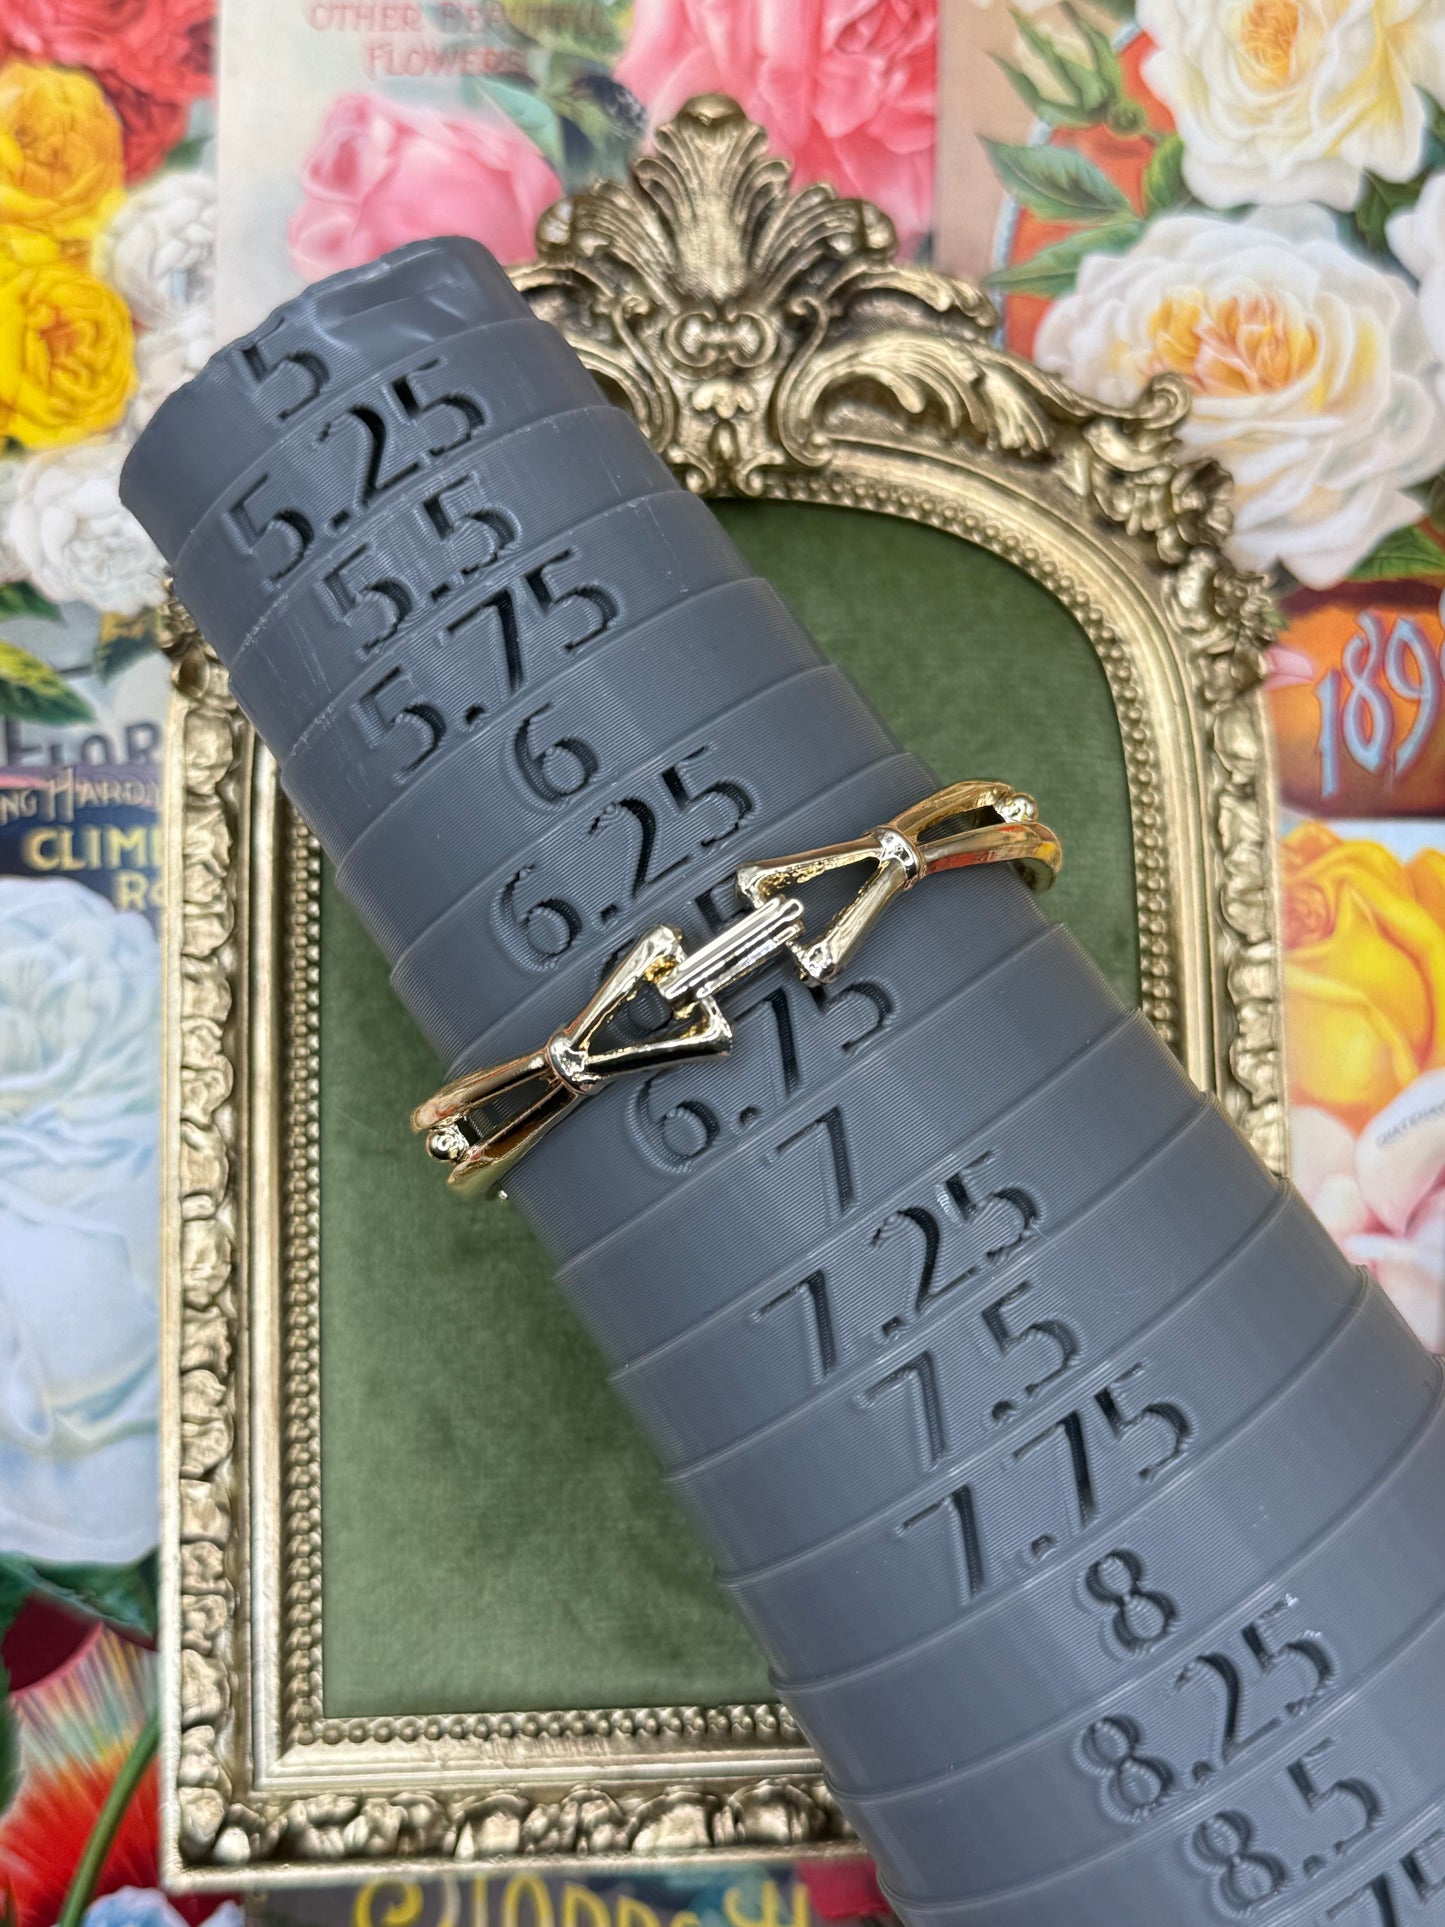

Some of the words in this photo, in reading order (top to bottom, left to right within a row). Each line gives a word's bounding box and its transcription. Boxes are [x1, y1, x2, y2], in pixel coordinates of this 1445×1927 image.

[302, 2, 422, 32] OTHER
[366, 45, 529, 76] FLOWERS
[236, 315, 330, 424] 5
[224, 354, 492, 592] 5.25
[314, 471, 522, 659] 5.5
[350, 545, 624, 783] 5.75
[507, 702, 600, 813] 6
[491, 741, 762, 972] 6.25
[626, 978, 896, 1174] 6.75
[761, 1104, 857, 1225] 7
[752, 1149, 1046, 1384] 7.25
[856, 1279, 1084, 1471] 7.5
[897, 1359, 1195, 1606] 7.75
[1078, 1548, 1181, 1659] 8
[1073, 1593, 1340, 1824] 8.25
[1185, 1736, 1385, 1920] 8.5
